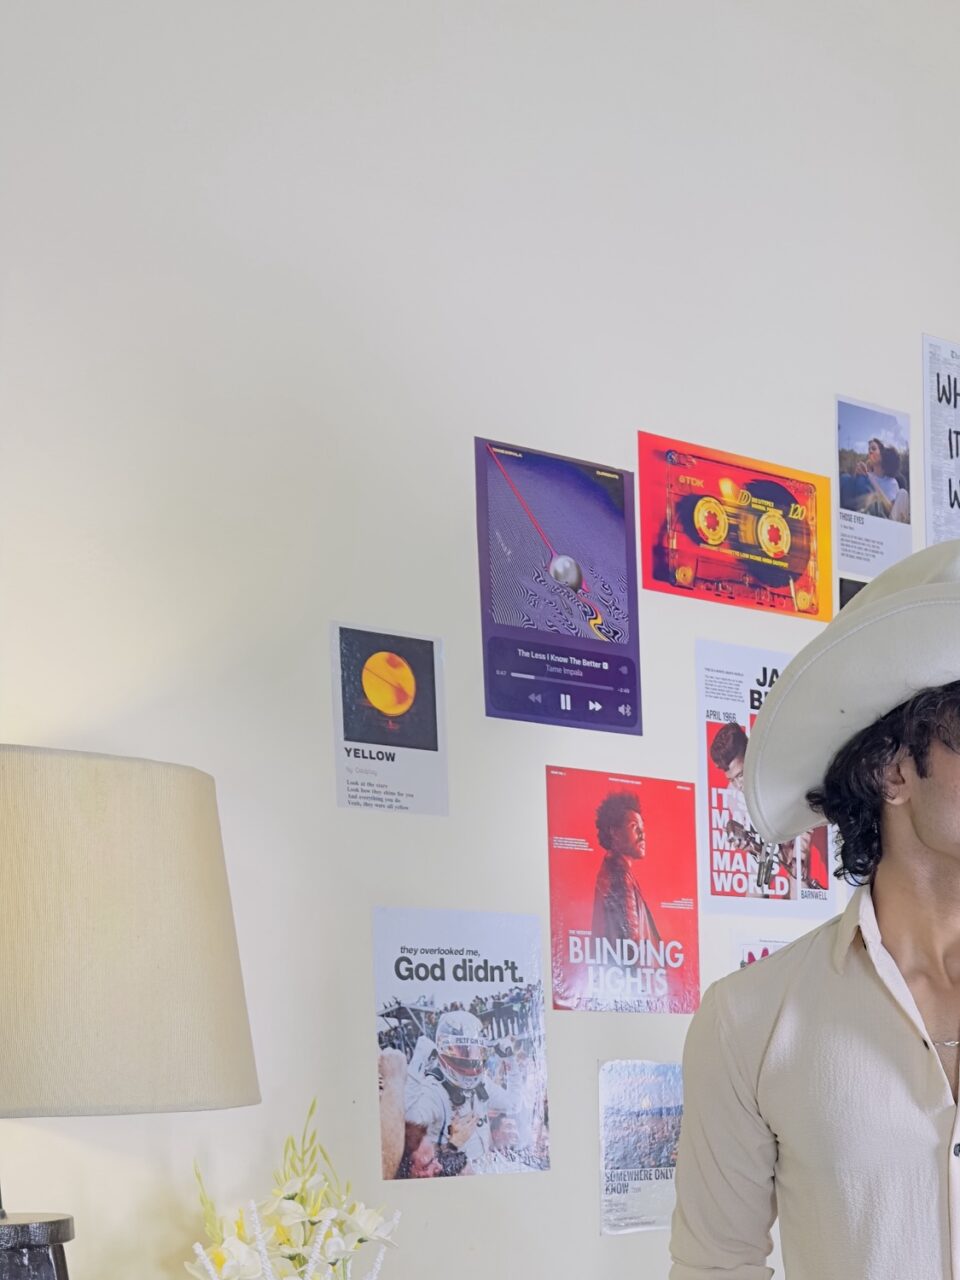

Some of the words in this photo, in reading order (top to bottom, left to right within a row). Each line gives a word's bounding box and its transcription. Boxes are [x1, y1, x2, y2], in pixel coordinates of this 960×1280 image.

[686, 475, 705, 487] TDK
[788, 503, 806, 520] 120
[839, 512, 853, 523] THOSE
[853, 514, 865, 525] EYES
[517, 648, 531, 658] The
[531, 651, 546, 661] Less
[550, 654, 569, 664] Know
[569, 656, 582, 666] The
[582, 658, 602, 669] Better
[546, 664, 562, 674] Tame
[706, 710, 721, 721] APRIL
[344, 746, 396, 762] YELLOW
[712, 872, 790, 897] WORLD
[800, 889, 828, 901] BARNWELL
[400, 945, 418, 956] they
[419, 946, 465, 956] overlooked
[465, 949, 481, 958] me,
[568, 936, 685, 969] BLINDING
[394, 956, 446, 982] God
[452, 957, 524, 983] didn't.
[588, 965, 669, 997] LIGHTS
[605, 1169, 653, 1183] SOMEWHERE
[654, 1168, 674, 1181] ONLY
[605, 1182, 629, 1195] KNOW
